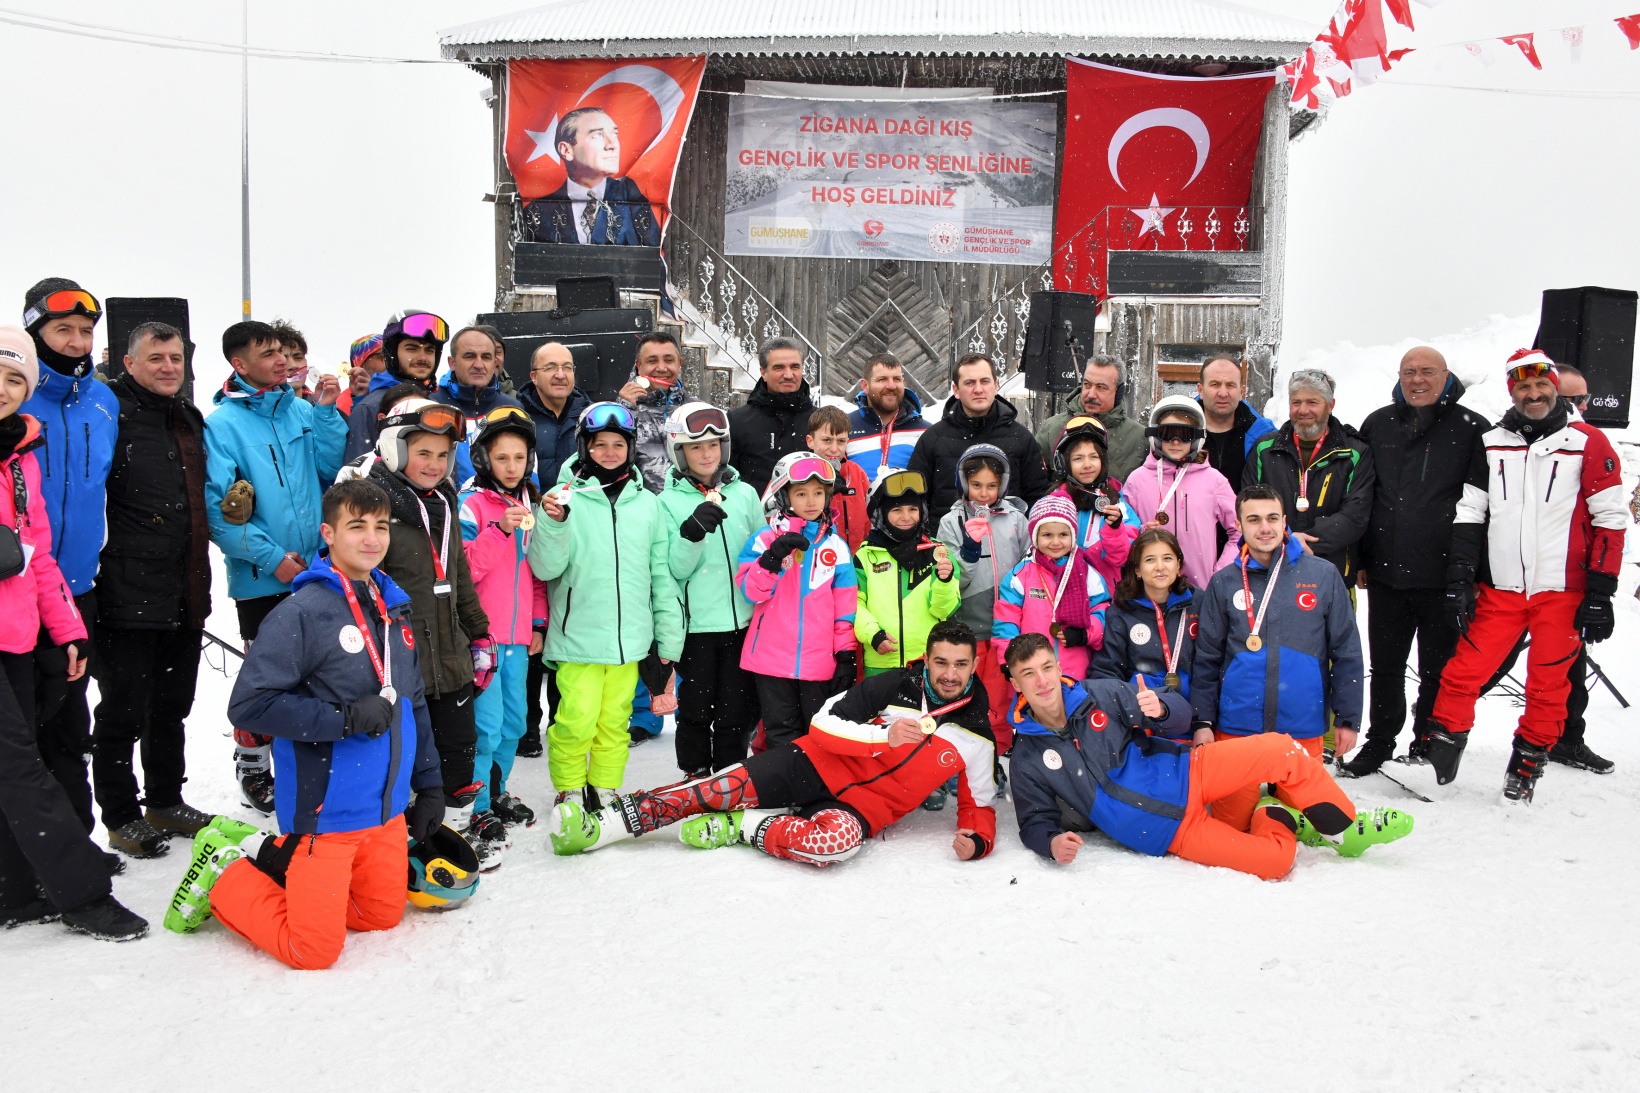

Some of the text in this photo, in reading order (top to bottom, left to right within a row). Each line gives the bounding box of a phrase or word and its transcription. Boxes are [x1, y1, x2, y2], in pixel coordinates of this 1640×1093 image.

[799, 111, 973, 141] ZİGANA DAĞI KIŞ
[738, 147, 1033, 175] GENÇLİK VE SPOR ŞENLİĞİNE
[811, 185, 957, 207] HOŞ GELDİNİZ
[750, 226, 809, 239] GÜMÜŞHANE
[964, 227, 1014, 236] GÜMÜŞHANE
[963, 235, 997, 246] GENÇLİK
[1009, 238, 1031, 246] SPOR
[963, 244, 1020, 254] İL MÜDÜRLÜĞÜ
[0, 350, 16, 358] UMA
[621, 794, 642, 832] ALBELLO
[172, 843, 217, 912] DALBELLO
